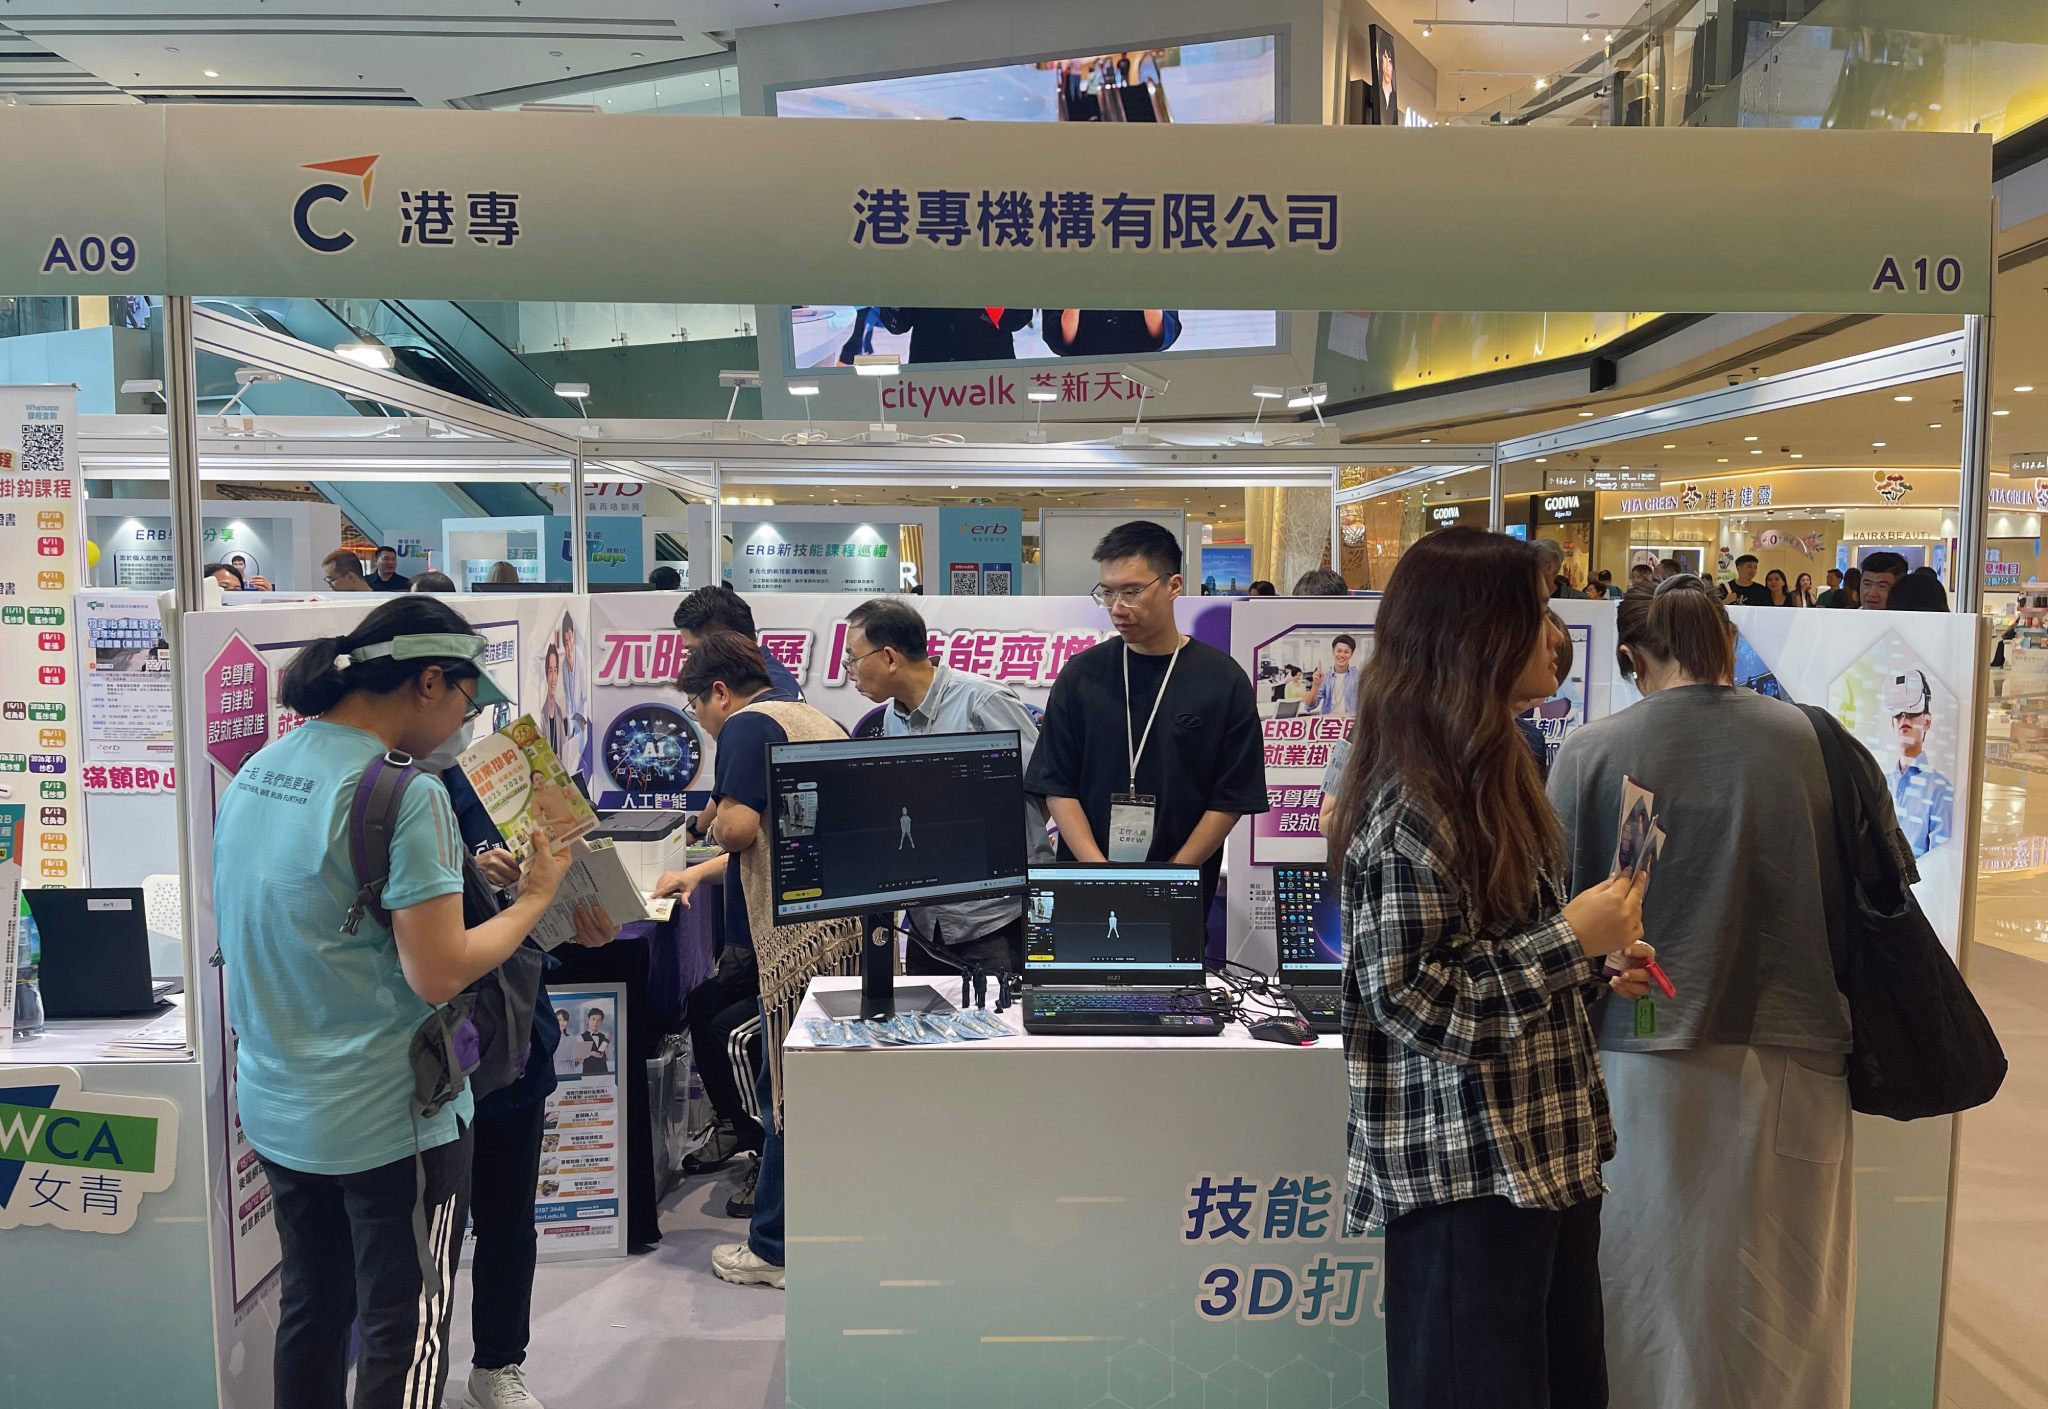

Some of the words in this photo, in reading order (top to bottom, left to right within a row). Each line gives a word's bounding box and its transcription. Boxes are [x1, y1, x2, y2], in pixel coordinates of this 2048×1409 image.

[401, 191, 519, 245] 港專
[853, 189, 1338, 250] 港專機構有限公司
[42, 237, 136, 272] A09
[1873, 258, 1961, 291] A10
[882, 375, 1015, 418] citywalk
[588, 502, 640, 511] 員再培訓局
[1545, 496, 1580, 511] GODIVA
[1621, 498, 1642, 512] VITA
[1644, 496, 1679, 511] GREEN
[1705, 485, 1772, 510] 維特健靈
[2007, 490, 2034, 505] GREEN
[1434, 507, 1460, 519] GODIVA
[971, 523, 1008, 535] erb
[1853, 531, 1932, 540] HAIR&BEAUTY
[745, 543, 889, 558] ERB新技能課程巡禮
[599, 635, 807, 680] 不限歷
[220, 663, 255, 687] 免學費
[220, 688, 255, 714] 有津貼
[208, 714, 265, 744] 設就業跟進
[643, 741, 666, 757] AI
[1264, 744, 1334, 767] 就業掛
[260, 788, 270, 797] WE
[271, 790, 283, 800] RUN
[283, 795, 308, 805] FURTHER
[484, 775, 524, 806] 2025-2026
[621, 793, 687, 809] 人工智能
[1267, 788, 1321, 808] 免學費
[28, 1170, 123, 1216] 女青
[1186, 1176, 1385, 1239] 技能
[1200, 1258, 1386, 1321] 3D打
